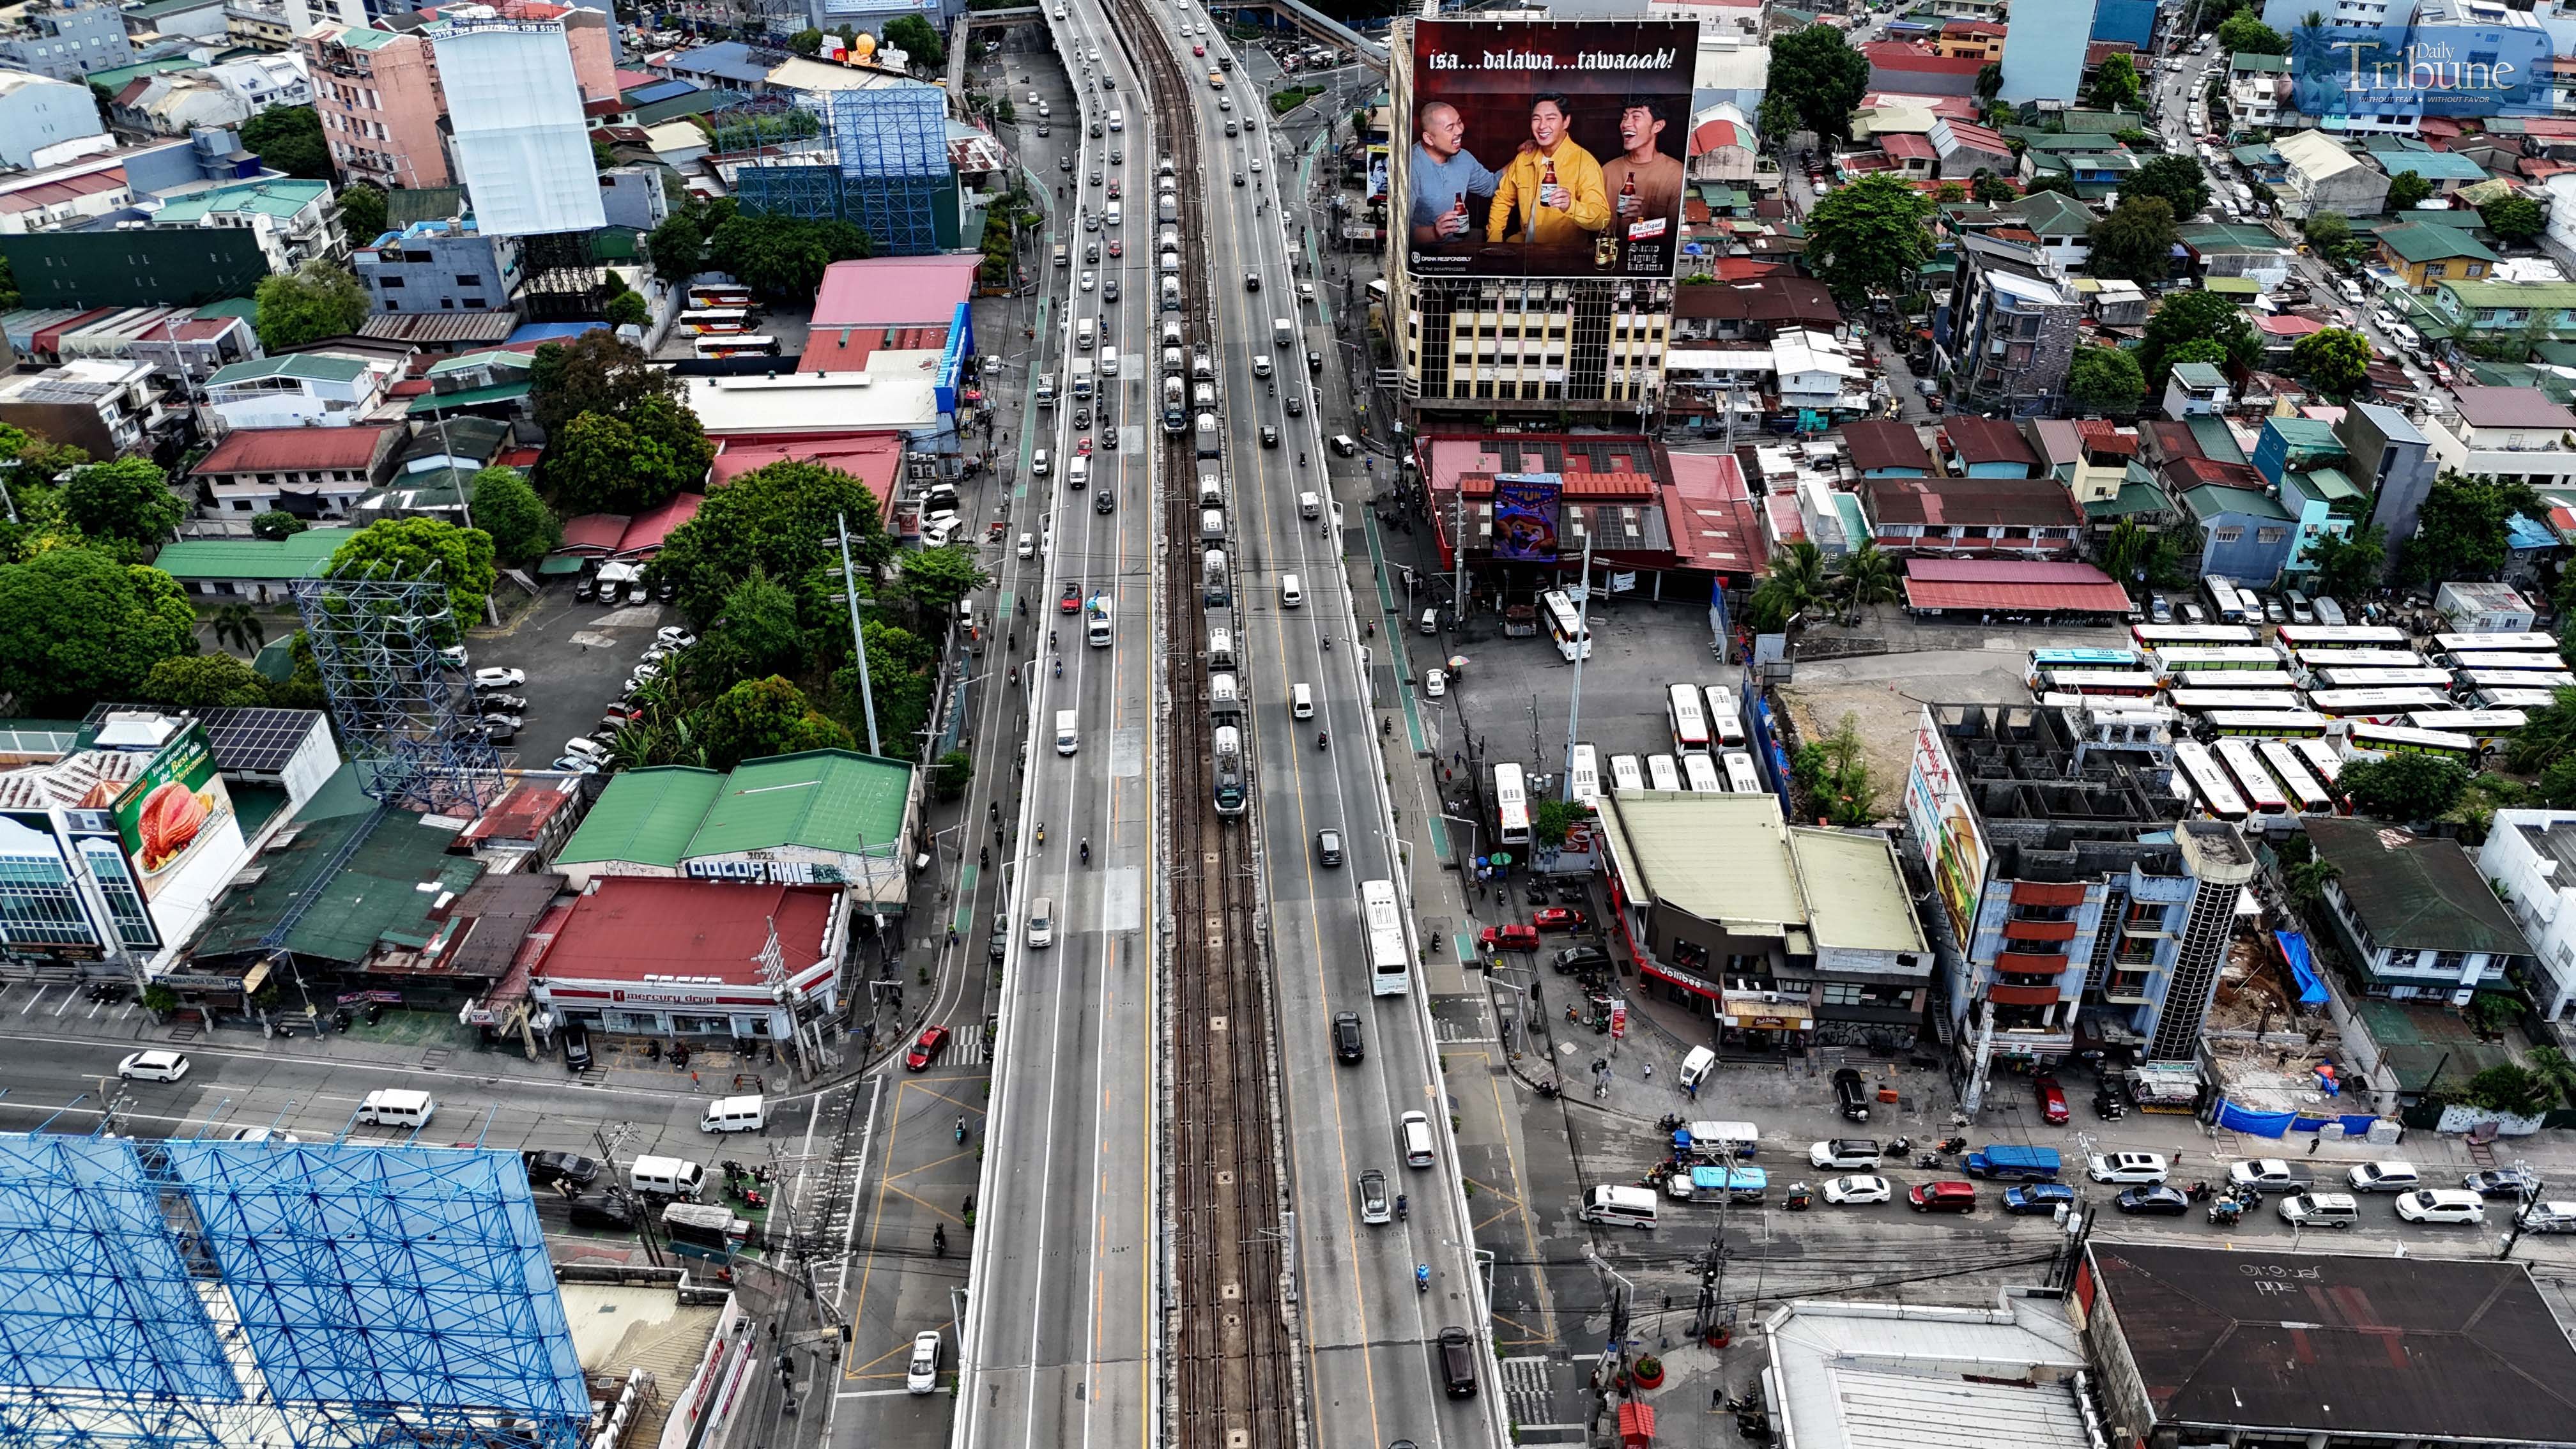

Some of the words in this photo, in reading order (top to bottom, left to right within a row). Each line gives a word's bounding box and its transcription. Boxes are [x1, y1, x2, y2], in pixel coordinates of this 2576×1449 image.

[1628, 243, 1660, 254] Sarap
[1627, 261, 1664, 271] kasama
[1517, 490, 1541, 501] FUN
[151, 763, 165, 777] You
[165, 739, 190, 765] deserve
[160, 770, 171, 783] the
[171, 752, 190, 774] Best
[188, 741, 201, 756] this
[172, 749, 208, 786] Christmas
[747, 852, 774, 860] 2023
[1659, 967, 1701, 988] Jollibee
[228, 980, 241, 988] RC
[627, 993, 680, 1002] mercury
[685, 994, 713, 1004] drug
[2255, 1280, 2297, 1296] add
